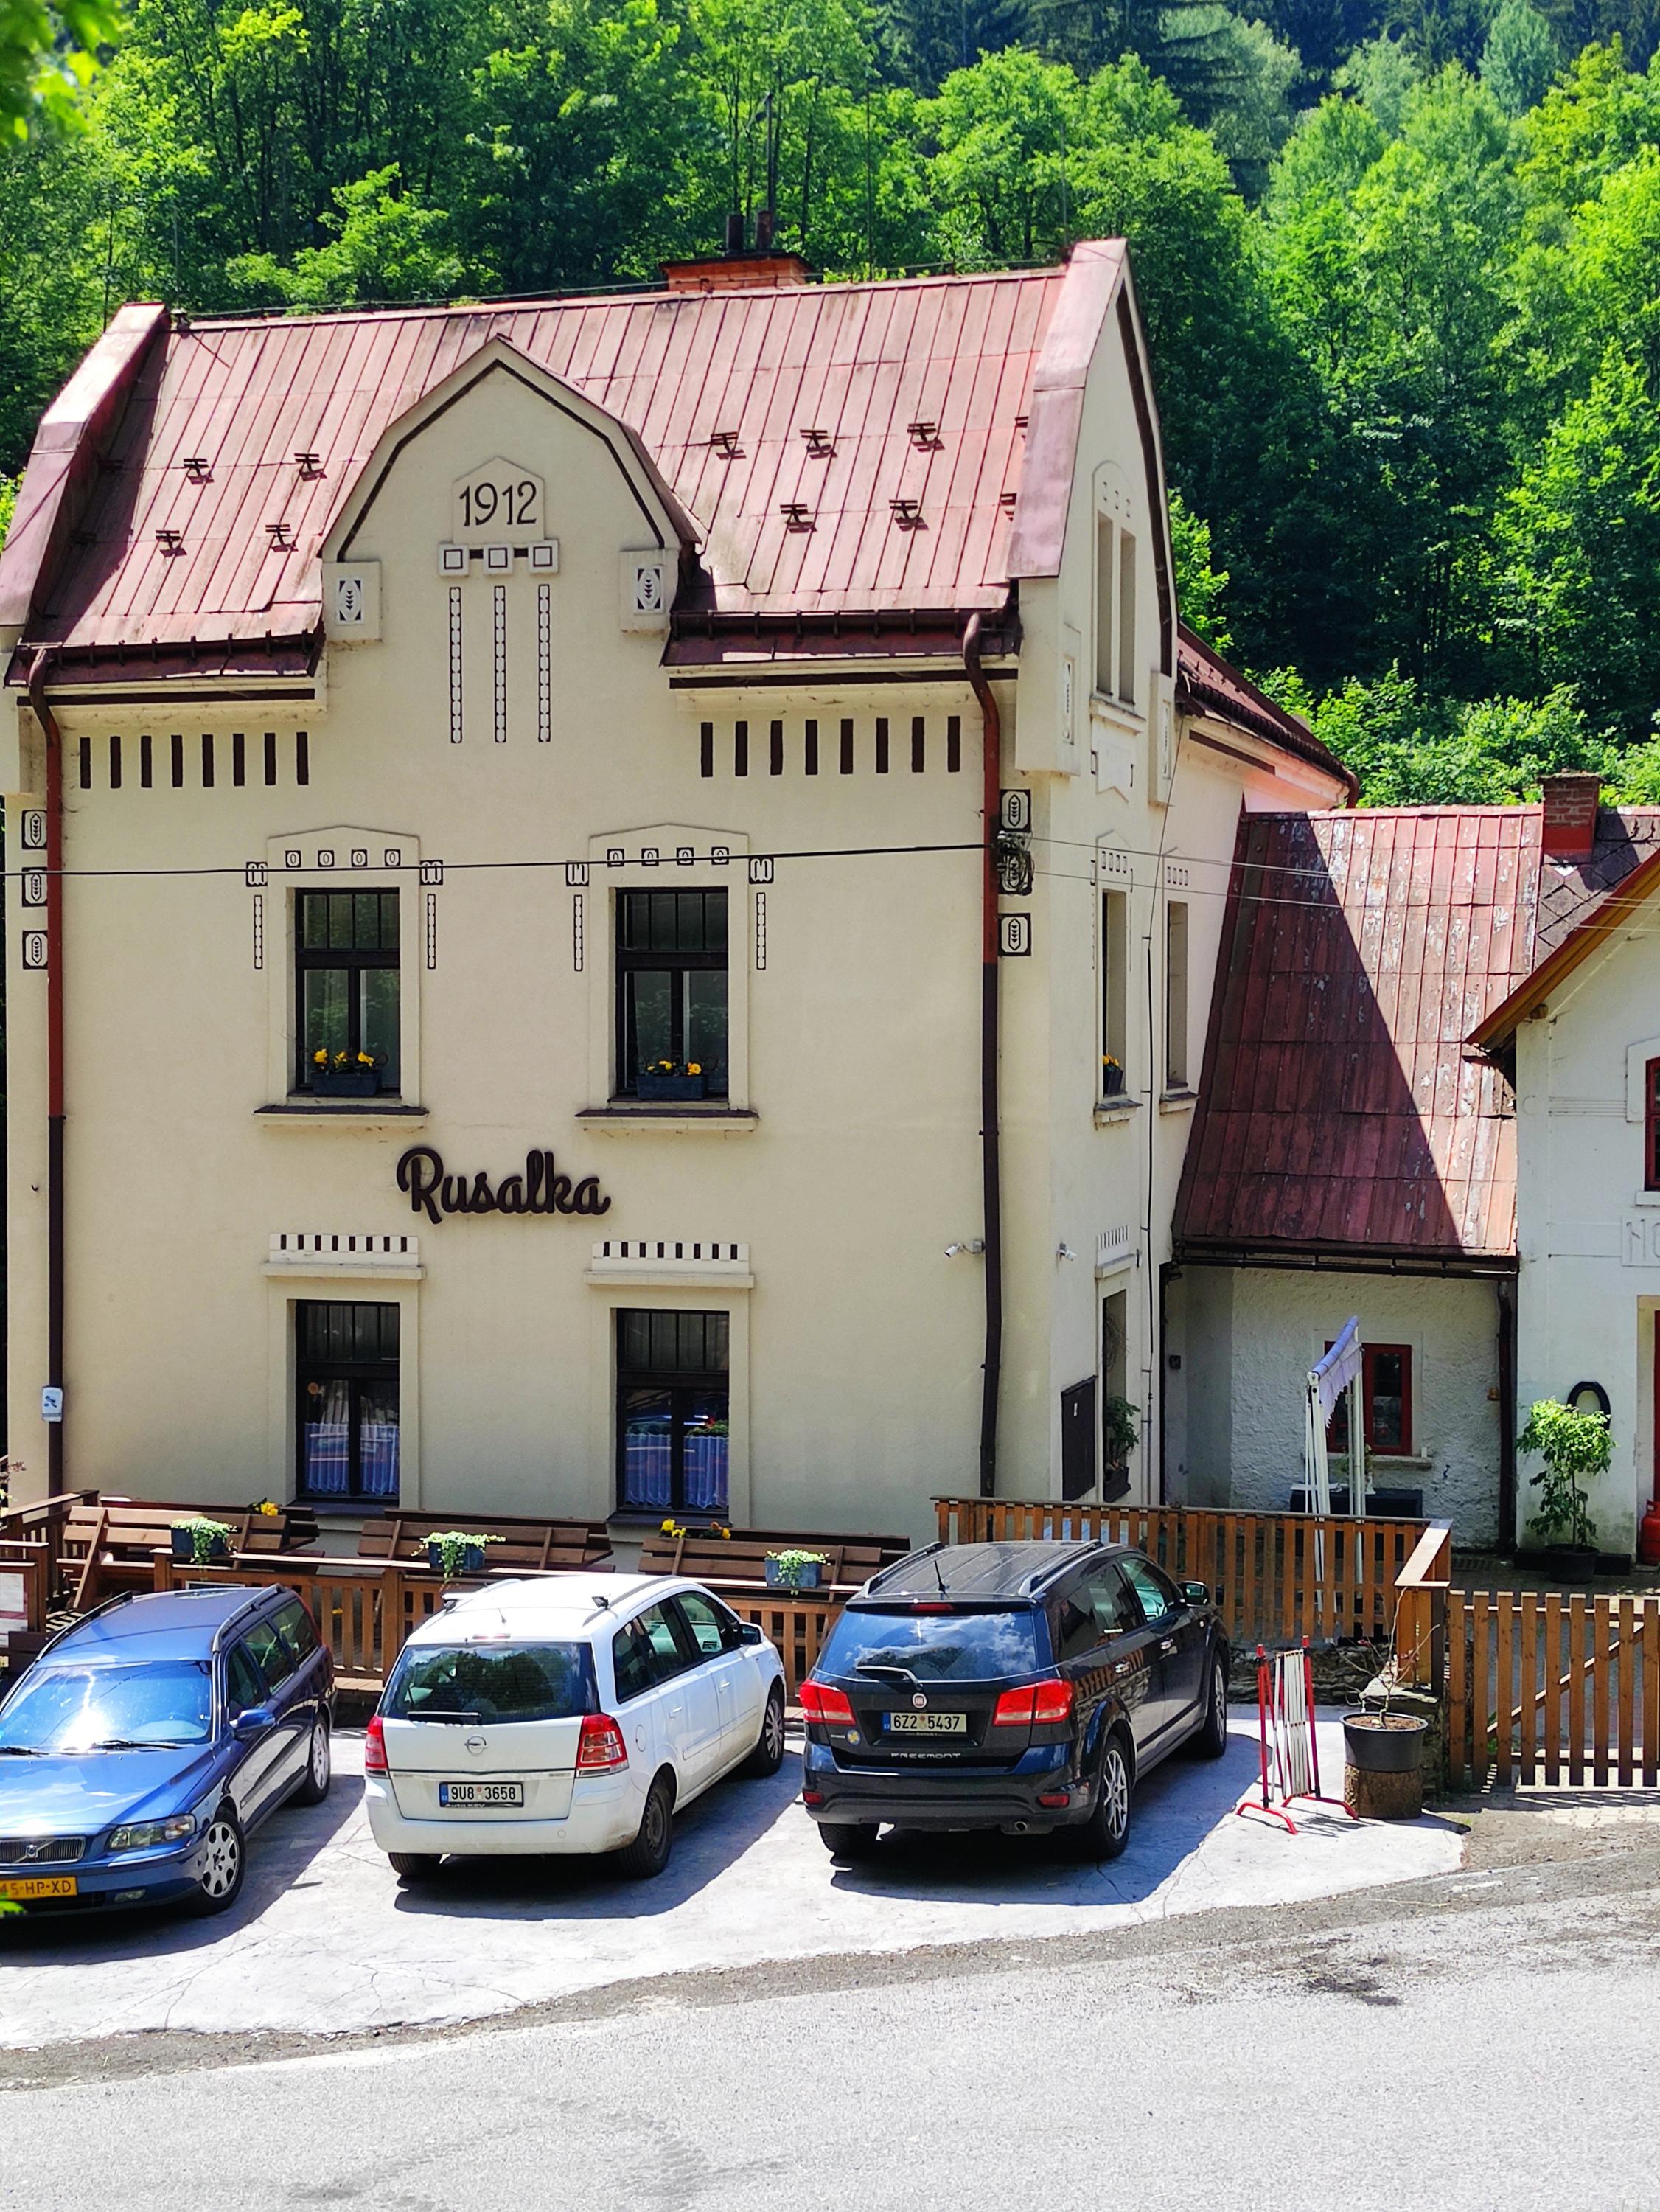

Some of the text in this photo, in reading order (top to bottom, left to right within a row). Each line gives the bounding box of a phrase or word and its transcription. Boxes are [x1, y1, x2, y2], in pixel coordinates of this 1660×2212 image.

[458, 481, 537, 526] 1912
[396, 1147, 611, 1224] Rusalka
[893, 1715, 960, 1730] 6Z2 5437
[451, 1786, 516, 1800] 9U8 3658
